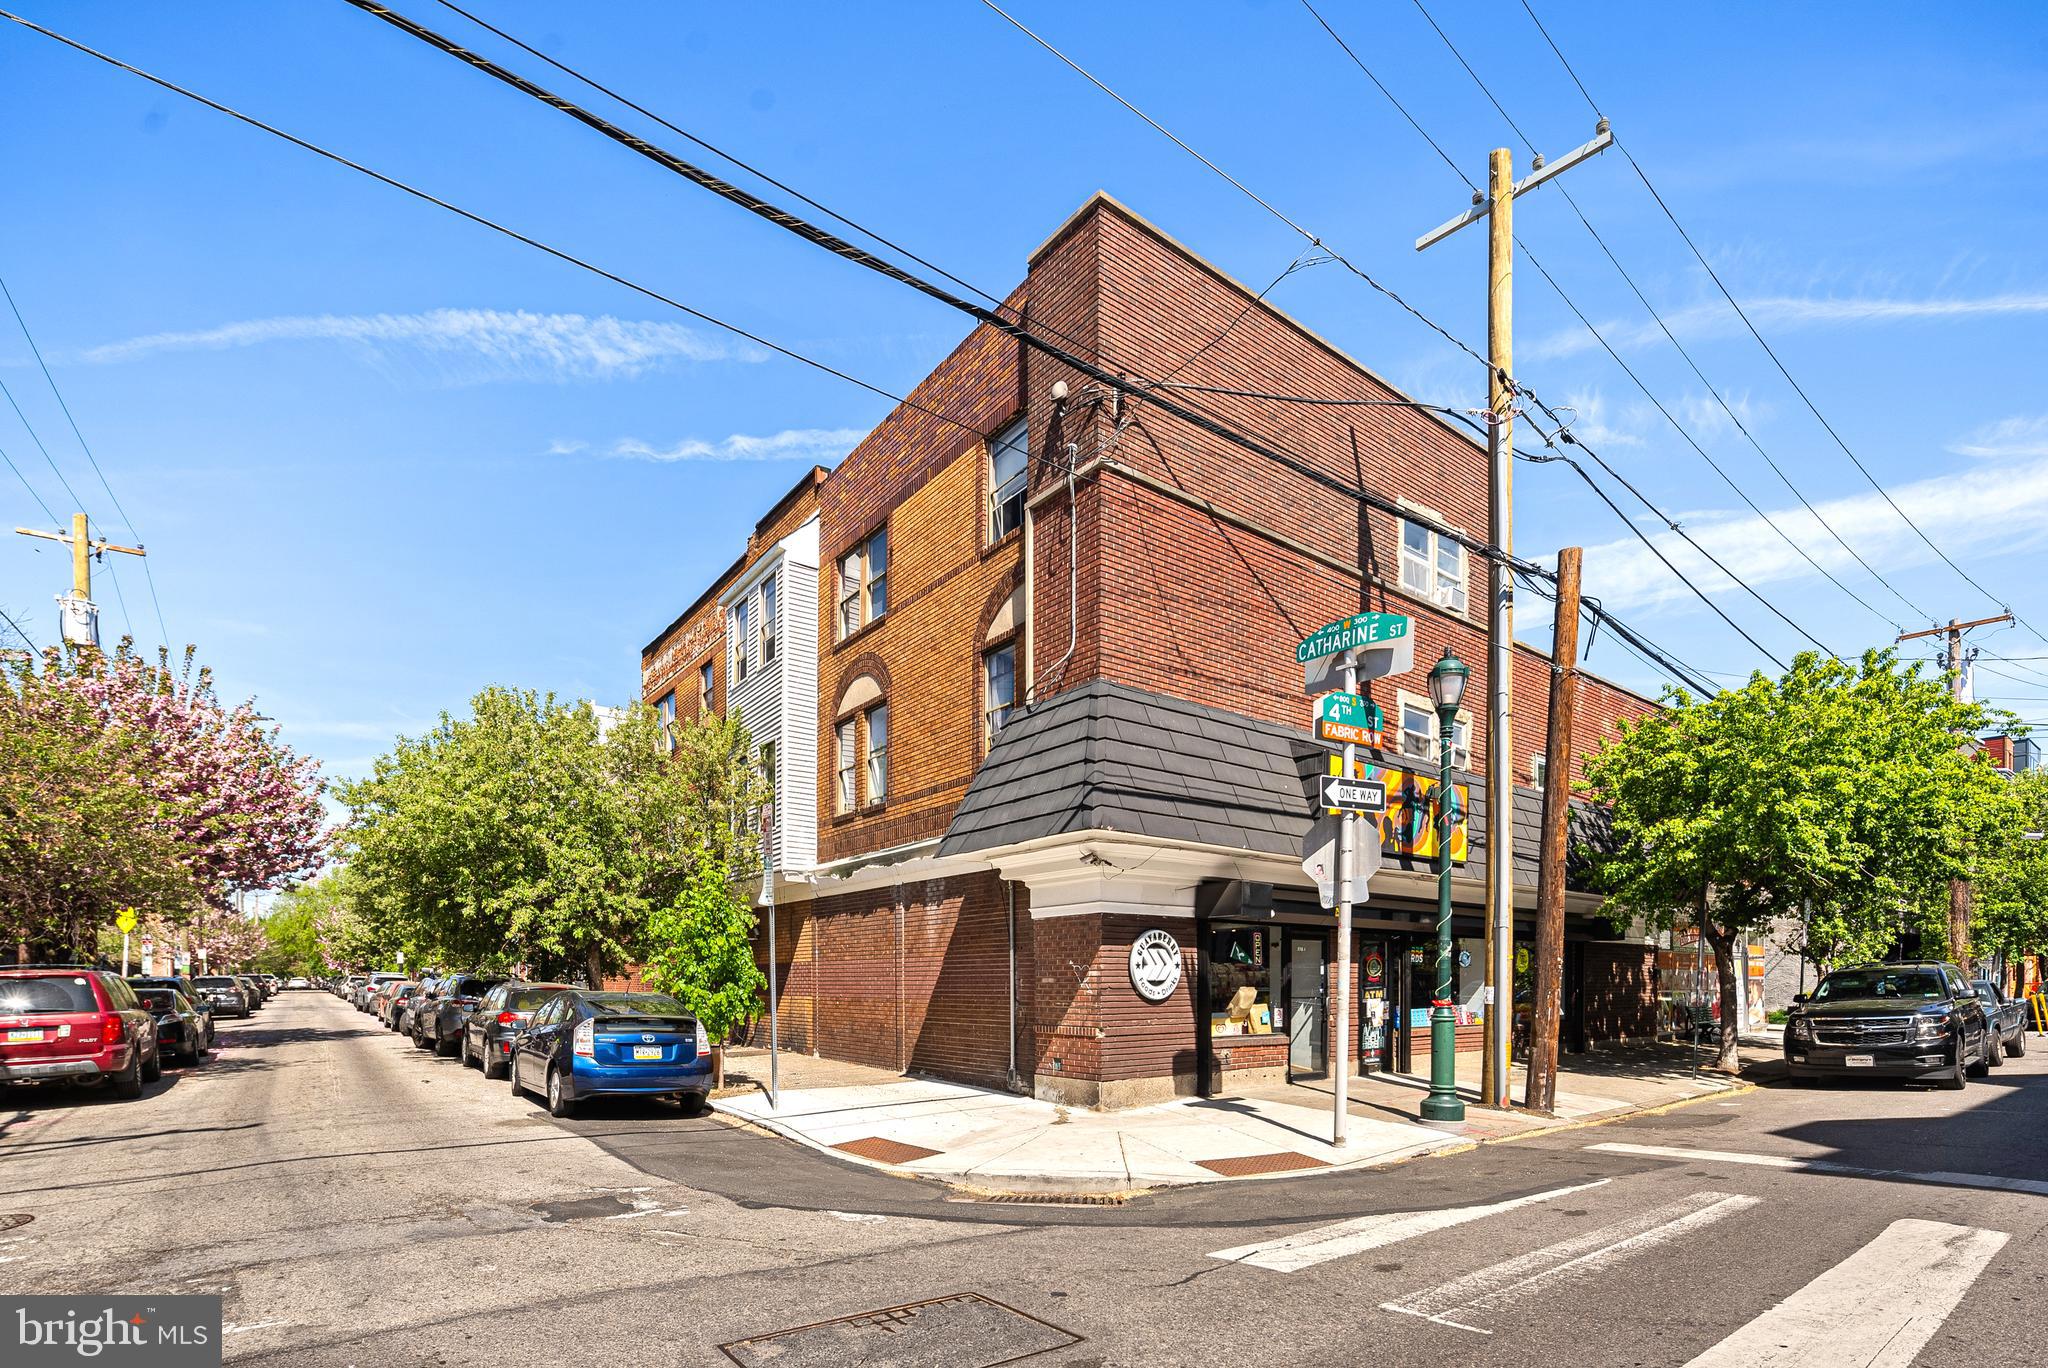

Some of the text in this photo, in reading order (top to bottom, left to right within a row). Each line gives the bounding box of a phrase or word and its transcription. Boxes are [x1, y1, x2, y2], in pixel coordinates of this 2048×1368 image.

[1343, 619, 1351, 630] W
[1298, 622, 1404, 661] CATHARINE ST
[1351, 697, 1357, 707] S
[1367, 715, 1380, 729] ST
[1324, 723, 1382, 744] FABRIC ROW
[1340, 787, 1378, 802] ONE WAY
[1364, 990, 1383, 999] ATM
